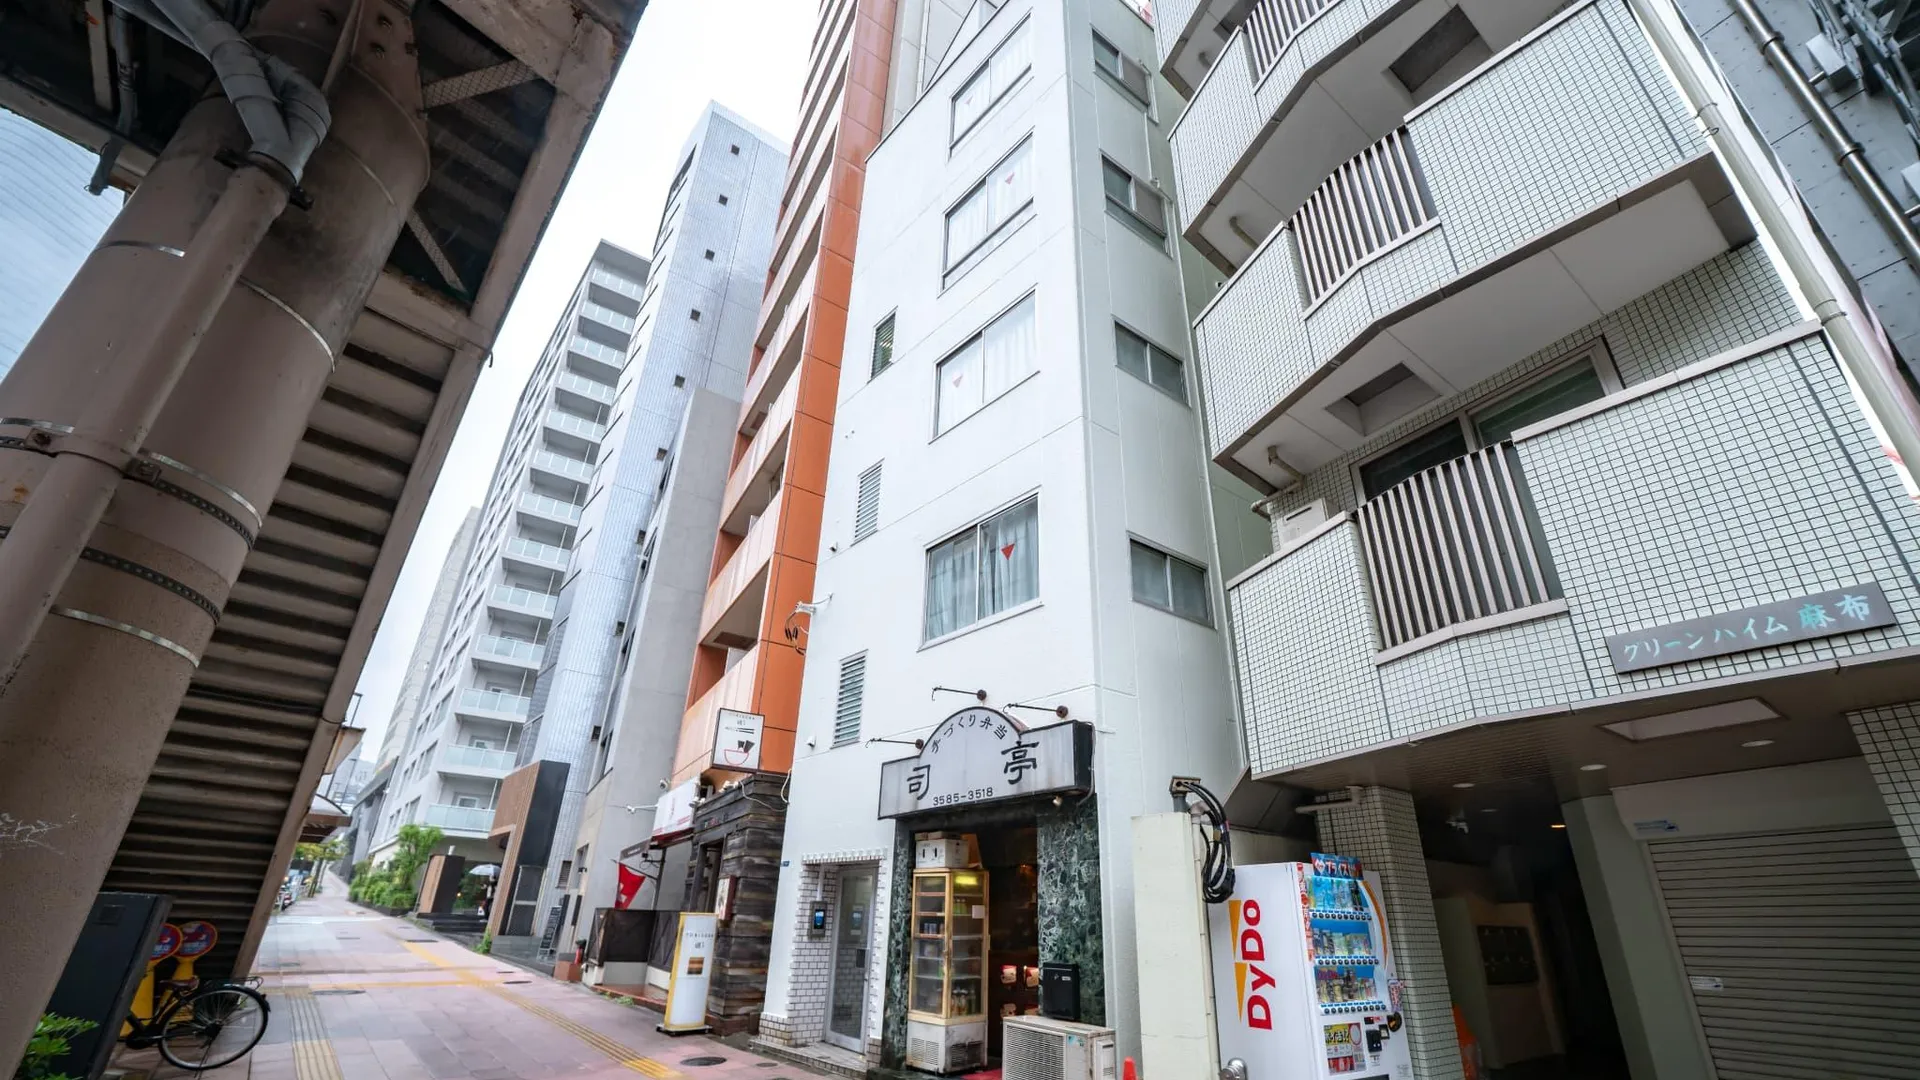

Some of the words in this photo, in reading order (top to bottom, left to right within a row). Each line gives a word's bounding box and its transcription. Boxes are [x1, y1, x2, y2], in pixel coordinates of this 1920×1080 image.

[931, 713, 1008, 754] 手づくり弁当
[906, 763, 931, 801] 司
[1001, 740, 1040, 785] 亭
[932, 786, 994, 806] 3585-3518
